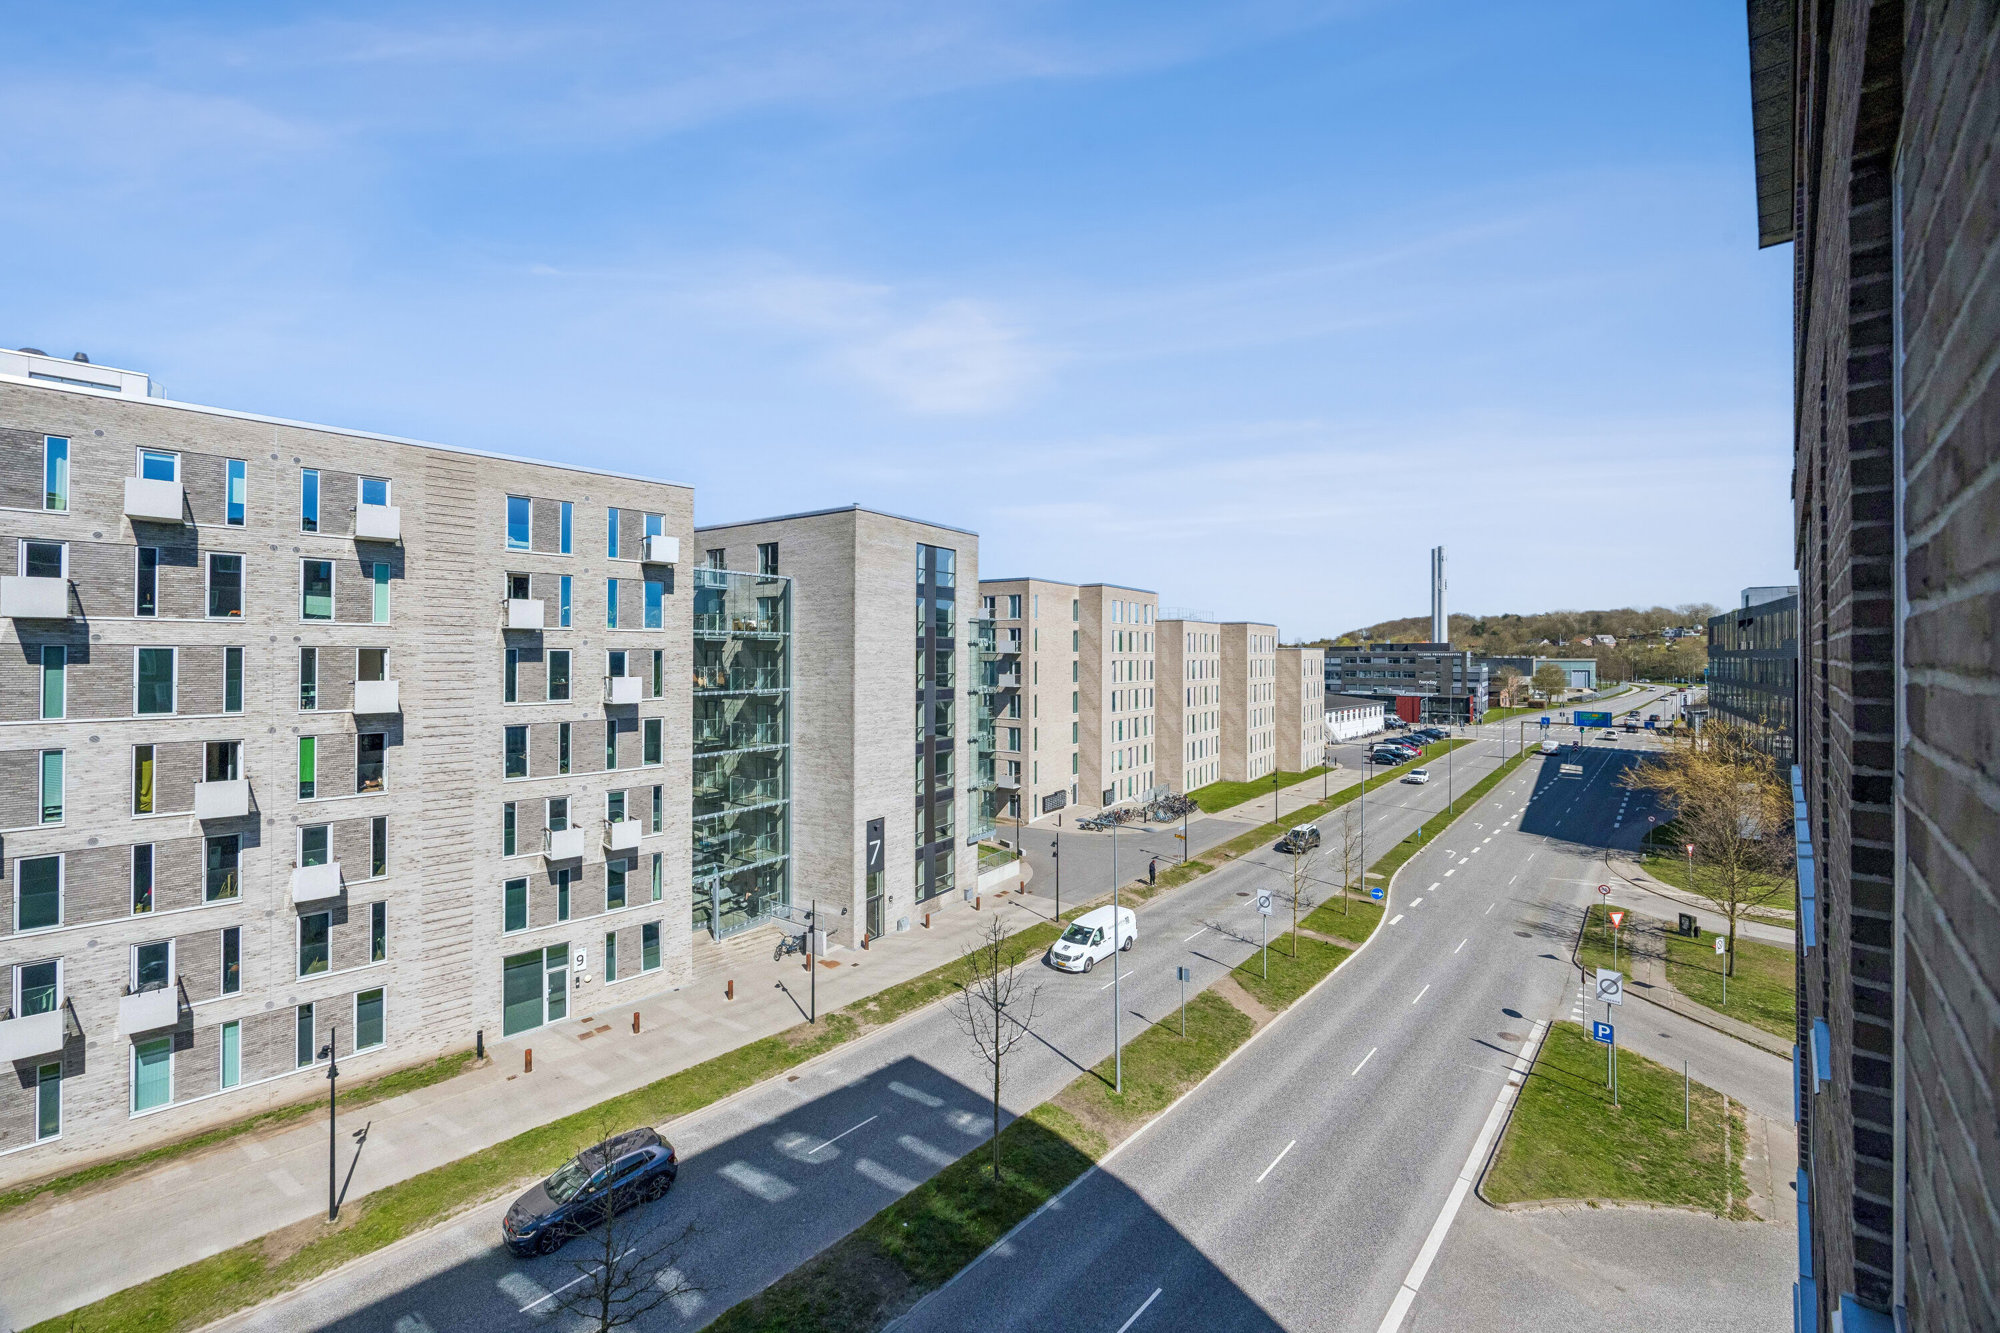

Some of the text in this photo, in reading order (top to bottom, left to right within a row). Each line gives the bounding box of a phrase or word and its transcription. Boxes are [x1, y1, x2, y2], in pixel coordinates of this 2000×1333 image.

[869, 839, 881, 865] 7
[576, 954, 584, 967] 9
[1598, 1024, 1611, 1037] P
